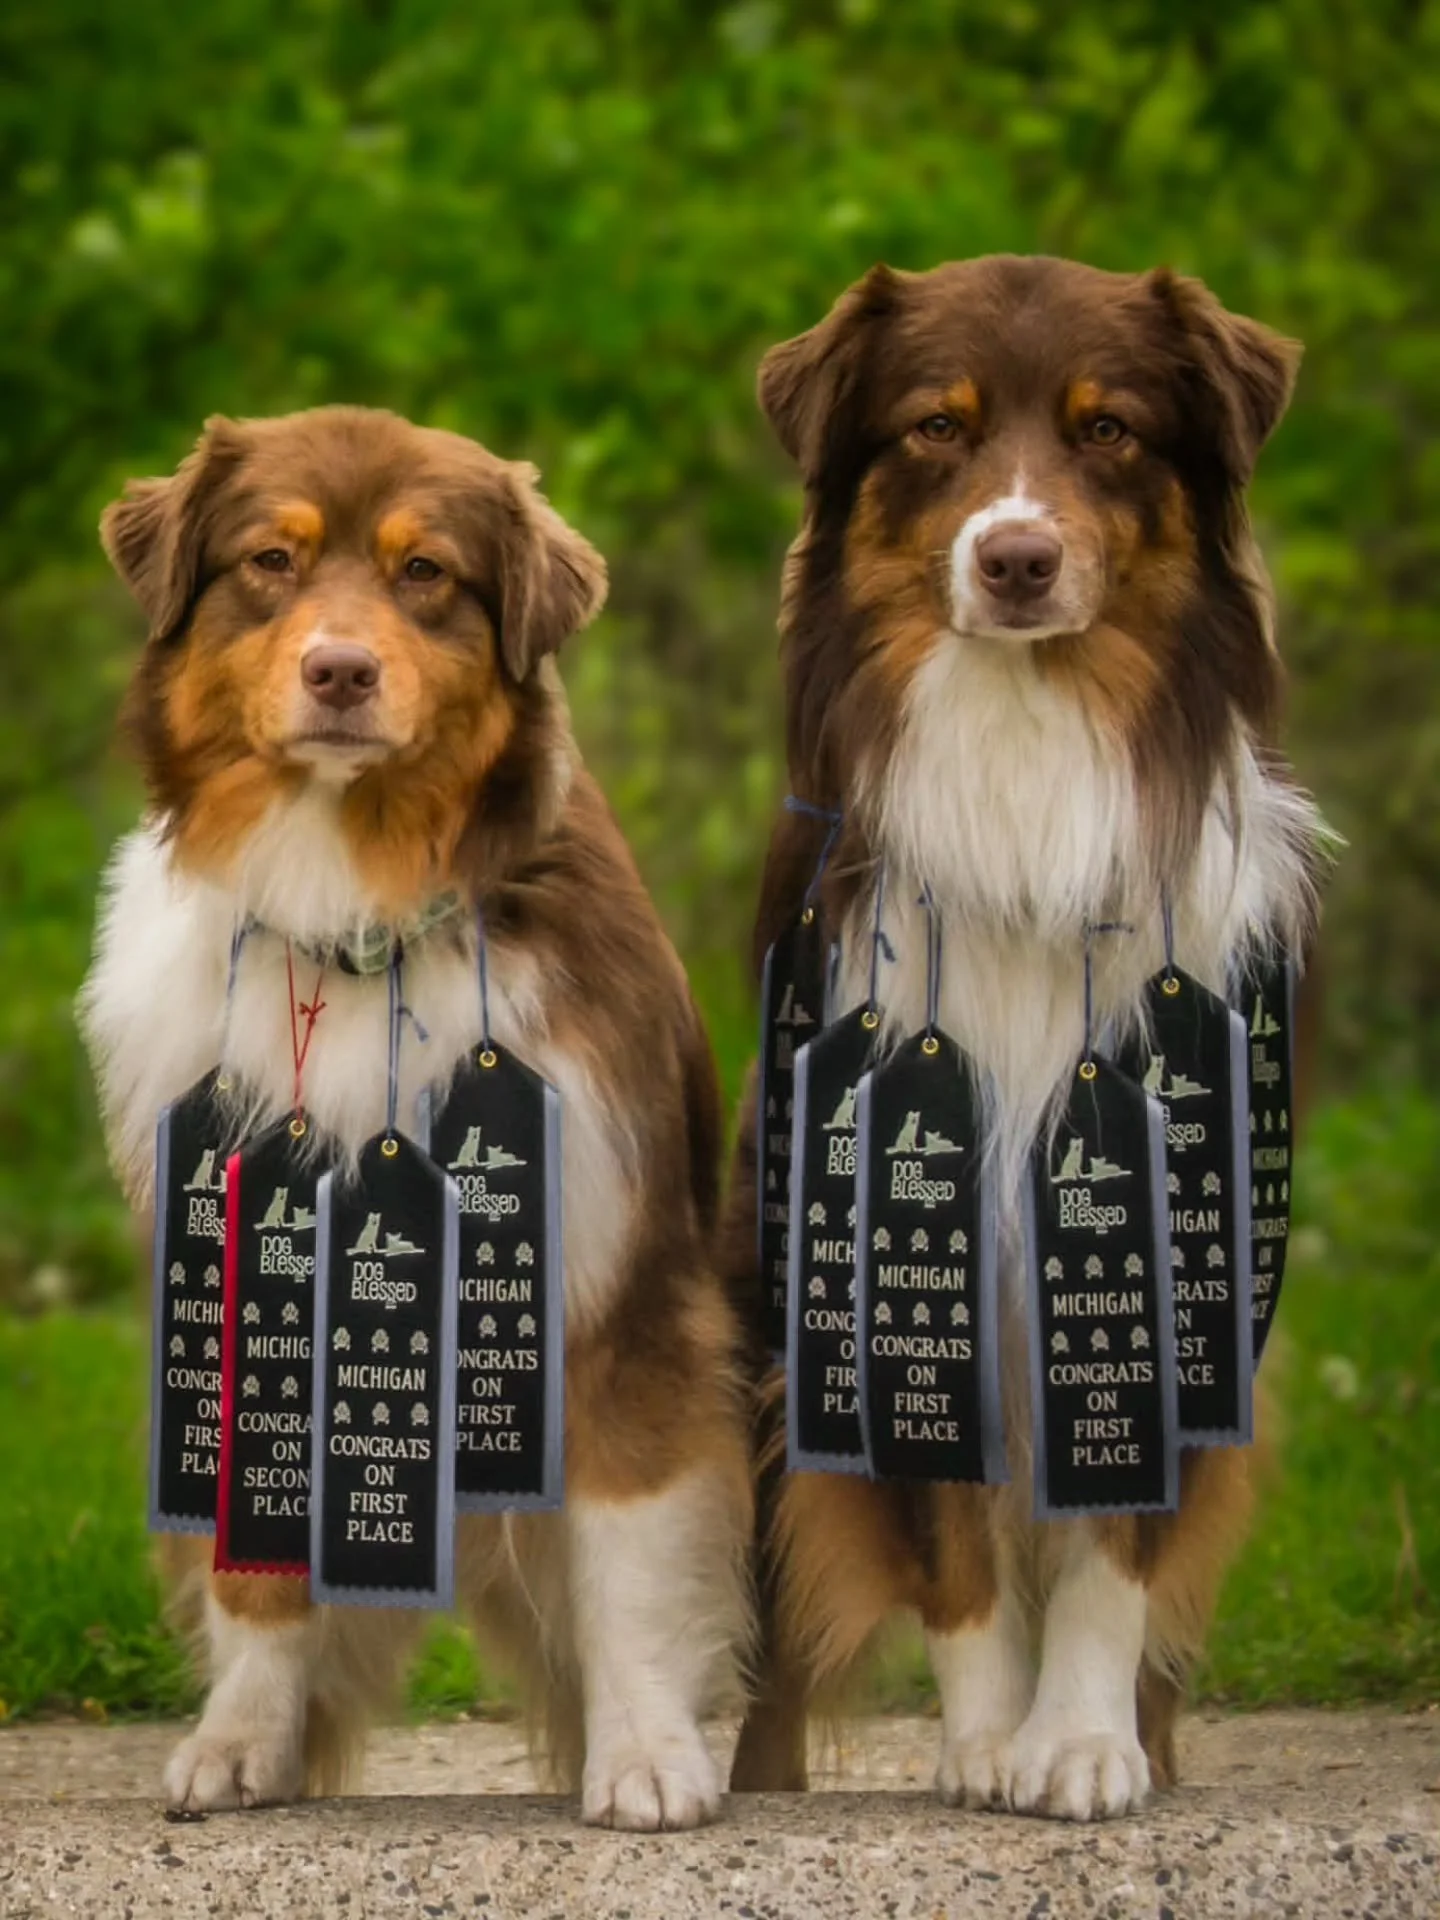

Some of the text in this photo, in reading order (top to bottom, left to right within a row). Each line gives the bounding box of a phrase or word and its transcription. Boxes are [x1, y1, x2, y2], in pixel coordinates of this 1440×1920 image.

[892, 1160, 923, 1180] DOG
[189, 1197, 217, 1217] DOG
[1060, 1187, 1092, 1208] DOG
[261, 1235, 292, 1255] DOG
[812, 1239, 856, 1264] MICH
[353, 1261, 384, 1281] DOG
[878, 1263, 965, 1291] MICHIGAN
[459, 1279, 532, 1302] ICHIGAN
[173, 1299, 225, 1324] MICHI
[1052, 1291, 1144, 1316] MICHIGAN
[804, 1308, 857, 1332] CONG
[246, 1336, 313, 1359] MICHIG
[840, 1339, 855, 1359] O
[872, 1335, 972, 1360] CONGRATS
[167, 1367, 223, 1392] CONGR
[337, 1364, 426, 1391] MICHIGAN
[825, 1366, 857, 1387] FIR
[907, 1364, 936, 1385] ON
[1049, 1361, 1154, 1385] CONGRATS
[1178, 1364, 1215, 1385] ACE
[472, 1377, 502, 1397] ON
[823, 1395, 860, 1414] PLA
[894, 1391, 951, 1415] FIRST
[1086, 1390, 1118, 1412] ON
[238, 1412, 313, 1433] CONGRA
[458, 1404, 516, 1424] FIRST
[184, 1424, 222, 1448] FIRS
[893, 1418, 959, 1442] PLACE
[1073, 1417, 1133, 1440] FIRST
[272, 1441, 301, 1461] ON
[329, 1434, 431, 1459] CONGRATS
[456, 1431, 522, 1451] PLACE
[180, 1452, 219, 1476] PLA
[1072, 1444, 1141, 1467] PLACE
[243, 1466, 312, 1488] SECON
[364, 1464, 395, 1486] ON
[252, 1495, 311, 1516] PLAC
[349, 1491, 408, 1514] FIRST
[346, 1519, 414, 1543] PLACE
